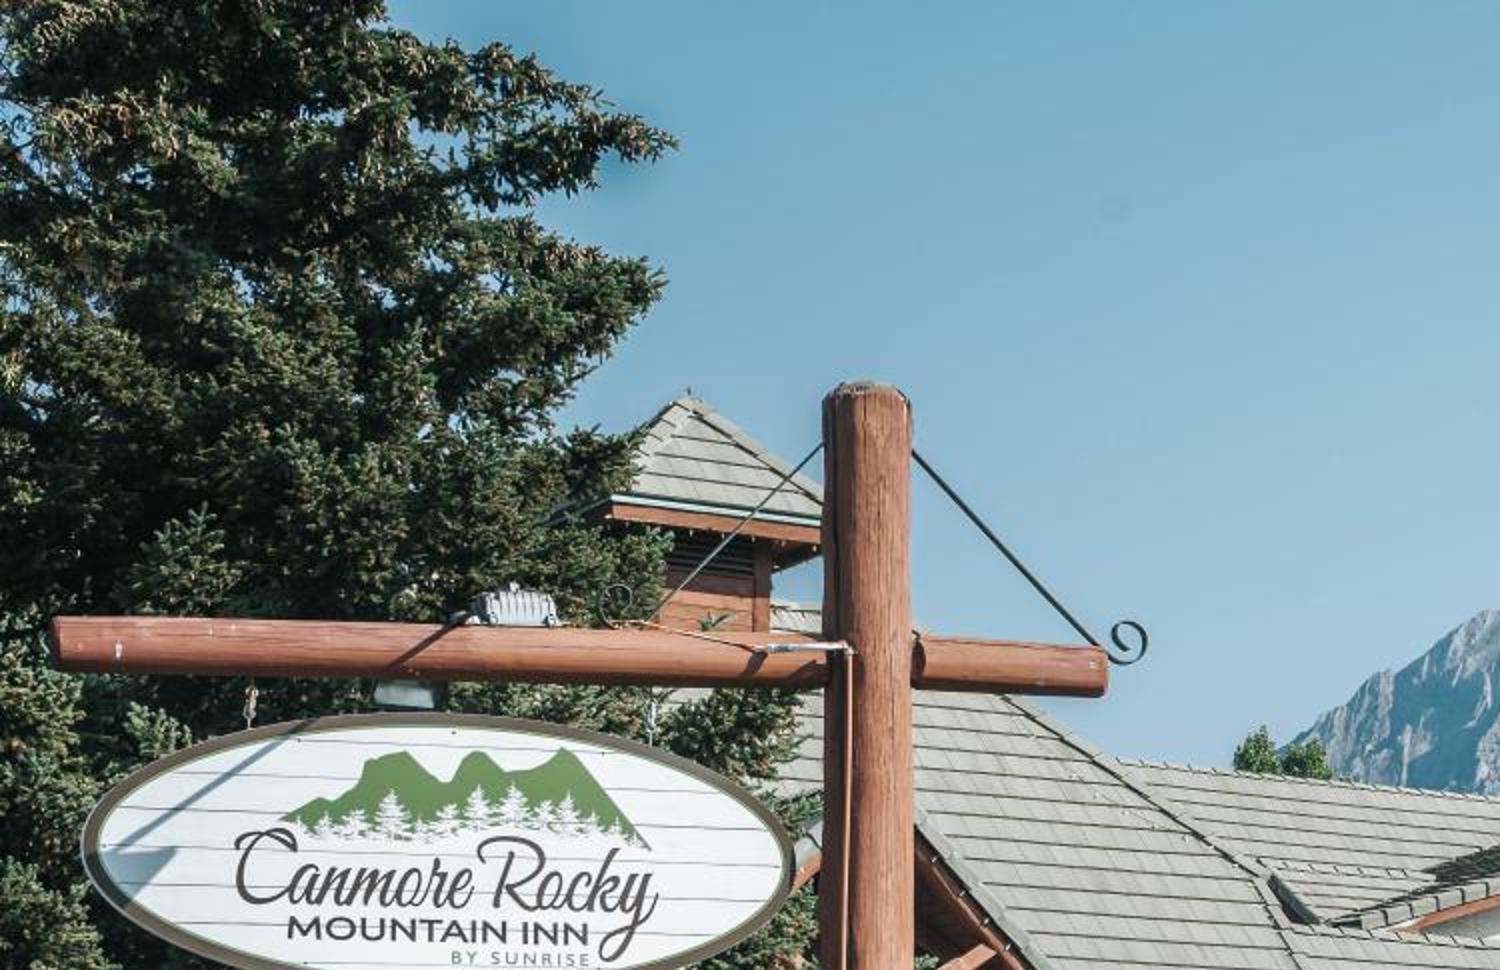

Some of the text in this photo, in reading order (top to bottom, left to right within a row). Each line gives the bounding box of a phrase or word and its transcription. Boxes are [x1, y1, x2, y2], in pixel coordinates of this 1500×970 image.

[234, 827, 659, 962] Canmore Rocky
[287, 915, 589, 946] MOUNTAIN INN
[451, 951, 589, 967] BY SUNRISE
